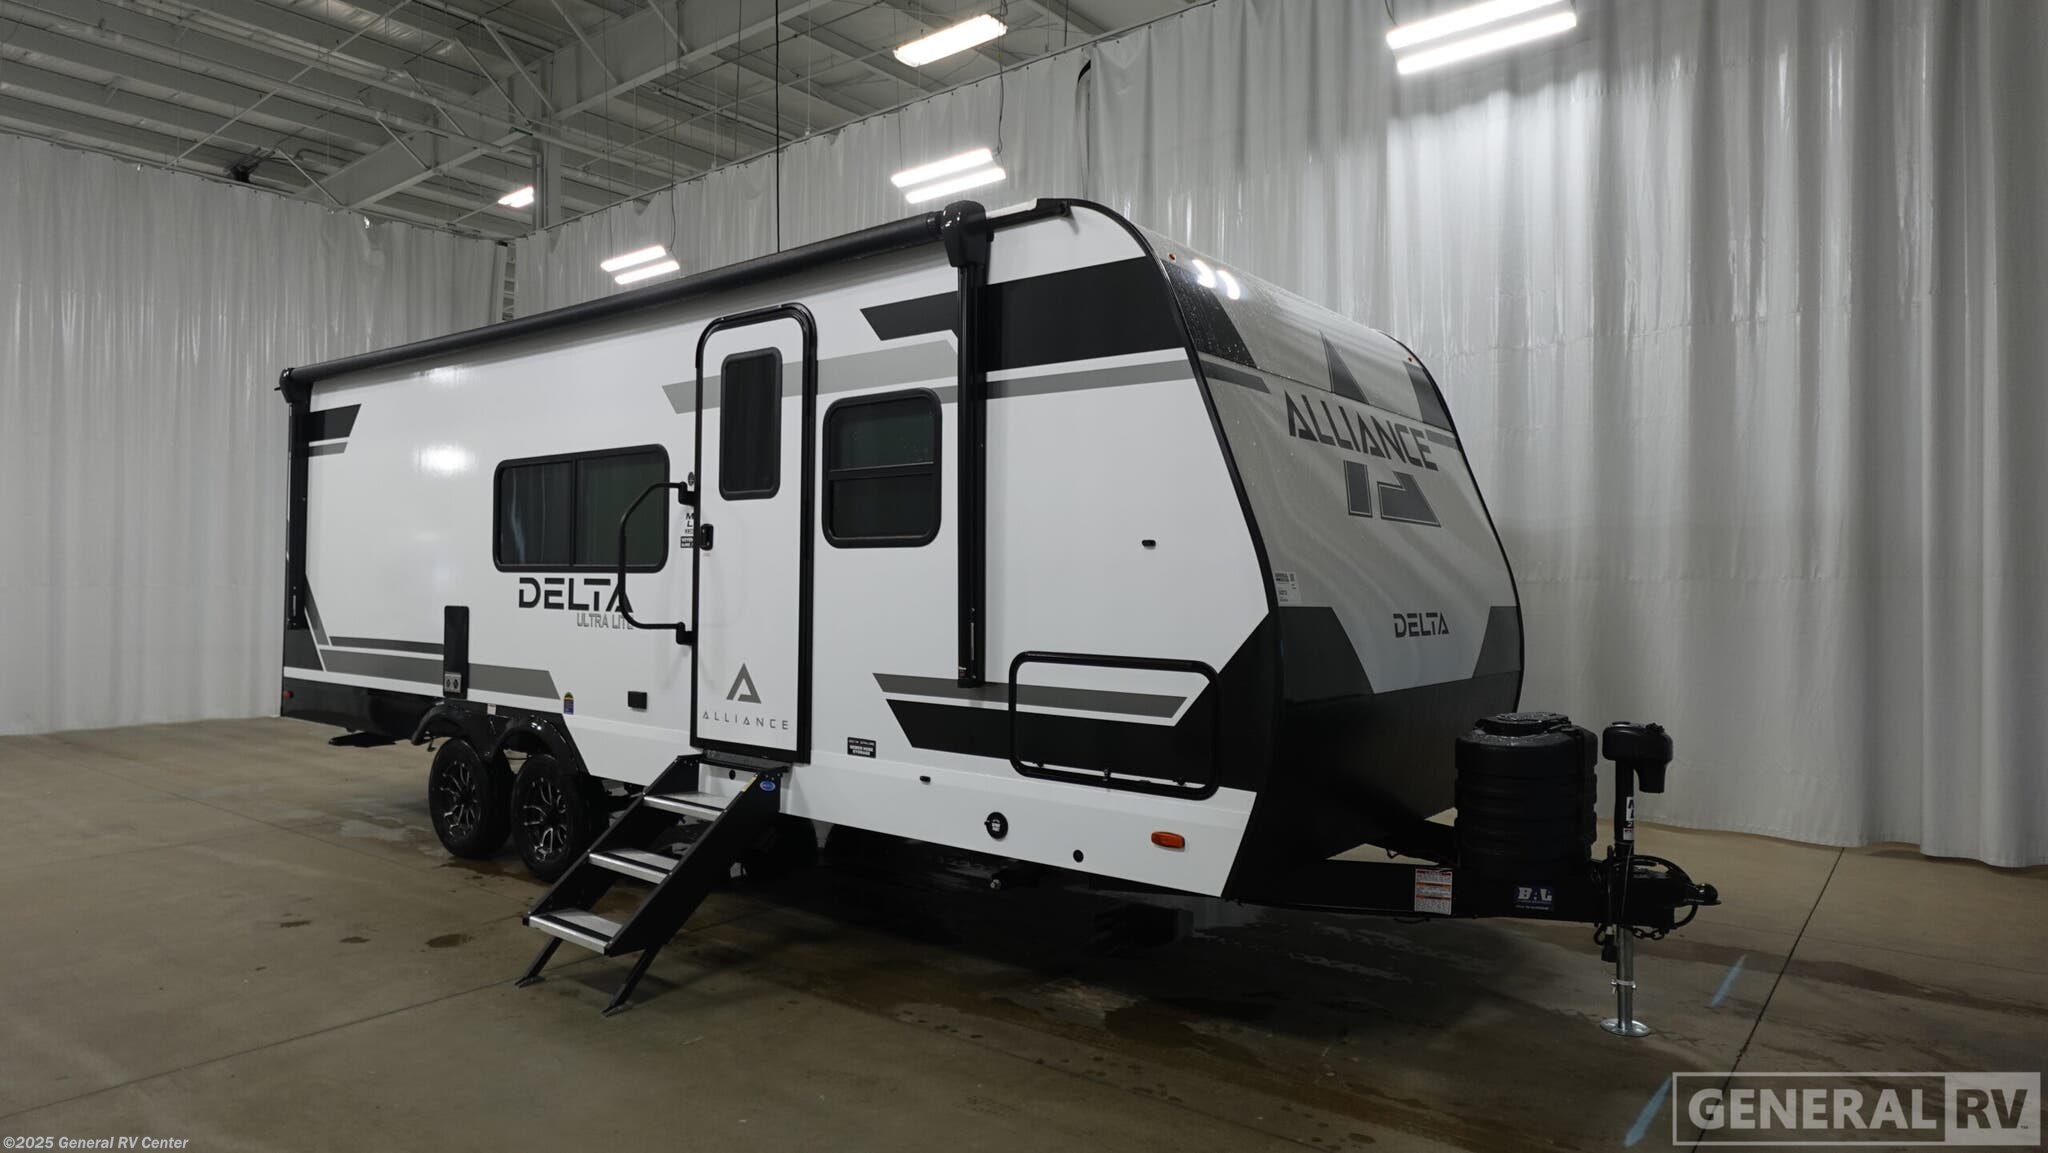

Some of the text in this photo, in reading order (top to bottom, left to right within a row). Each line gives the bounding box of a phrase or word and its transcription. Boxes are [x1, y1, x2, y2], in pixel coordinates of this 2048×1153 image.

[1284, 390, 1439, 472] ALLIANCE
[518, 576, 634, 613] DELTA
[576, 612, 609, 629] ULTRA
[1392, 612, 1450, 639] DELTA
[702, 710, 790, 731] ALLIANCE
